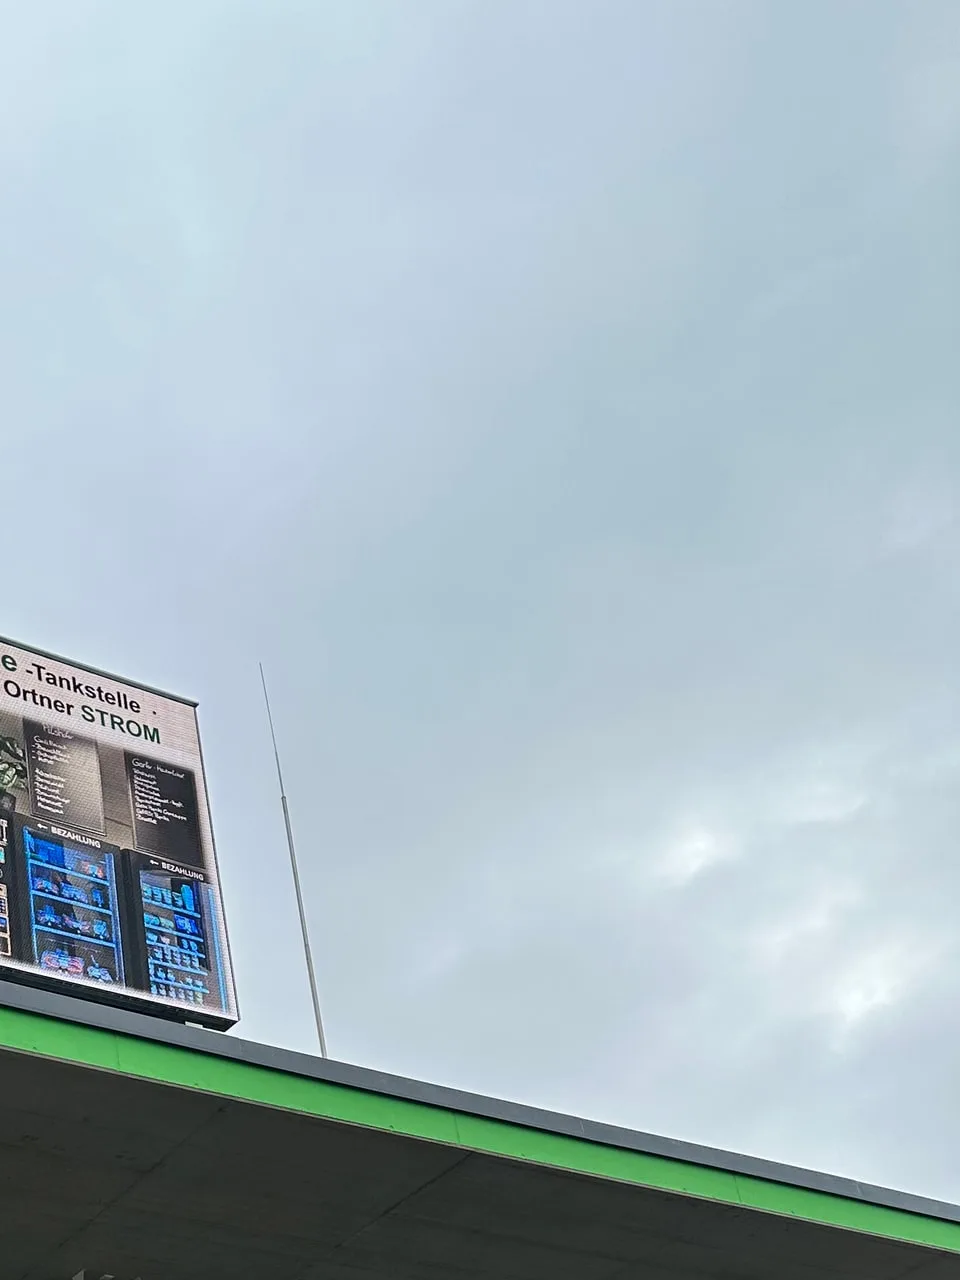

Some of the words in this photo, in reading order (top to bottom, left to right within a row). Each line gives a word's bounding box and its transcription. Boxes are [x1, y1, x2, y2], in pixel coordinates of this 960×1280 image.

[1, 654, 17, 672] e
[3, 679, 74, 716] Ortner
[81, 704, 161, 745] STROM
[50, 826, 101, 849] BEZAHLUNG
[161, 862, 204, 881] BEZAHLUNG
